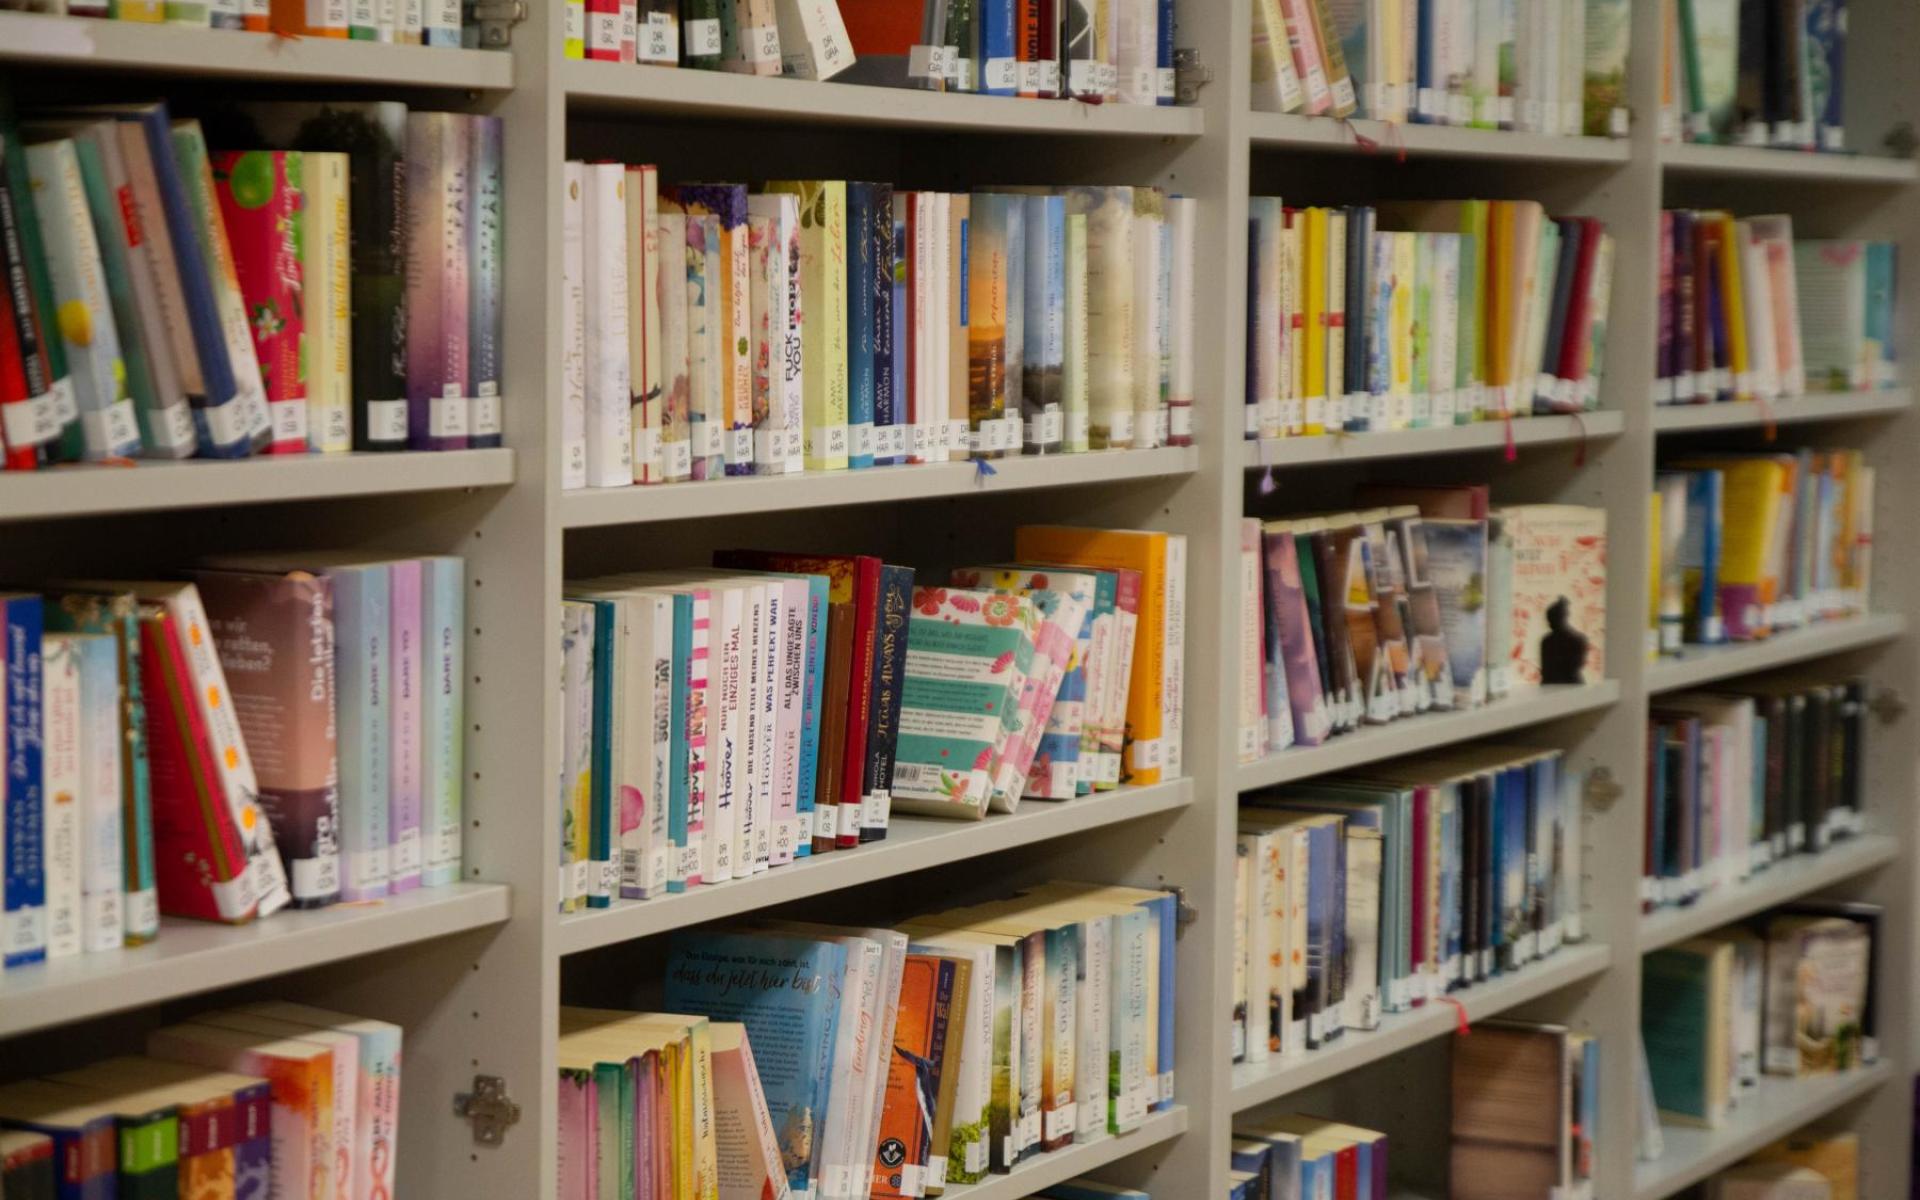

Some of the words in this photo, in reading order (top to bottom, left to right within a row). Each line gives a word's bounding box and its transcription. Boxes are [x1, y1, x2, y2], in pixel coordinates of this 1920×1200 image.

[785, 334, 794, 382] FUCK
[793, 337, 802, 377] YOU
[876, 382, 884, 409] AMY
[883, 366, 891, 423] HARMON
[308, 591, 326, 665] letzten
[752, 603, 760, 646] HERZENS
[768, 597, 779, 626] WAR
[794, 619, 803, 641] UNS
[722, 642, 730, 663] EIN
[730, 624, 741, 652] MAL
[766, 629, 778, 683] PERFEKT
[786, 606, 797, 665] UNGESAGTE
[309, 665, 327, 702] Die
[728, 654, 740, 712] EINZIGES
[750, 648, 758, 684] MEINES
[784, 668, 794, 689] DAS
[792, 644, 802, 695] ZWISCHEN
[720, 705, 729, 731] NUR
[749, 687, 757, 712] TEILE
[765, 684, 774, 712] WAS
[784, 691, 792, 709] ALL
[748, 713, 756, 756] TAUSEND
[718, 736, 733, 808] Hoover
[760, 721, 773, 797] HOOVER
[780, 728, 796, 807] HOOVER
[872, 751, 880, 788] NIKOLA
[880, 753, 888, 788] HOTEL
[651, 755, 665, 835] Hoover
[687, 747, 701, 824] Hoover
[744, 782, 754, 834] Hoover
[818, 1017, 832, 1081] FLYING
